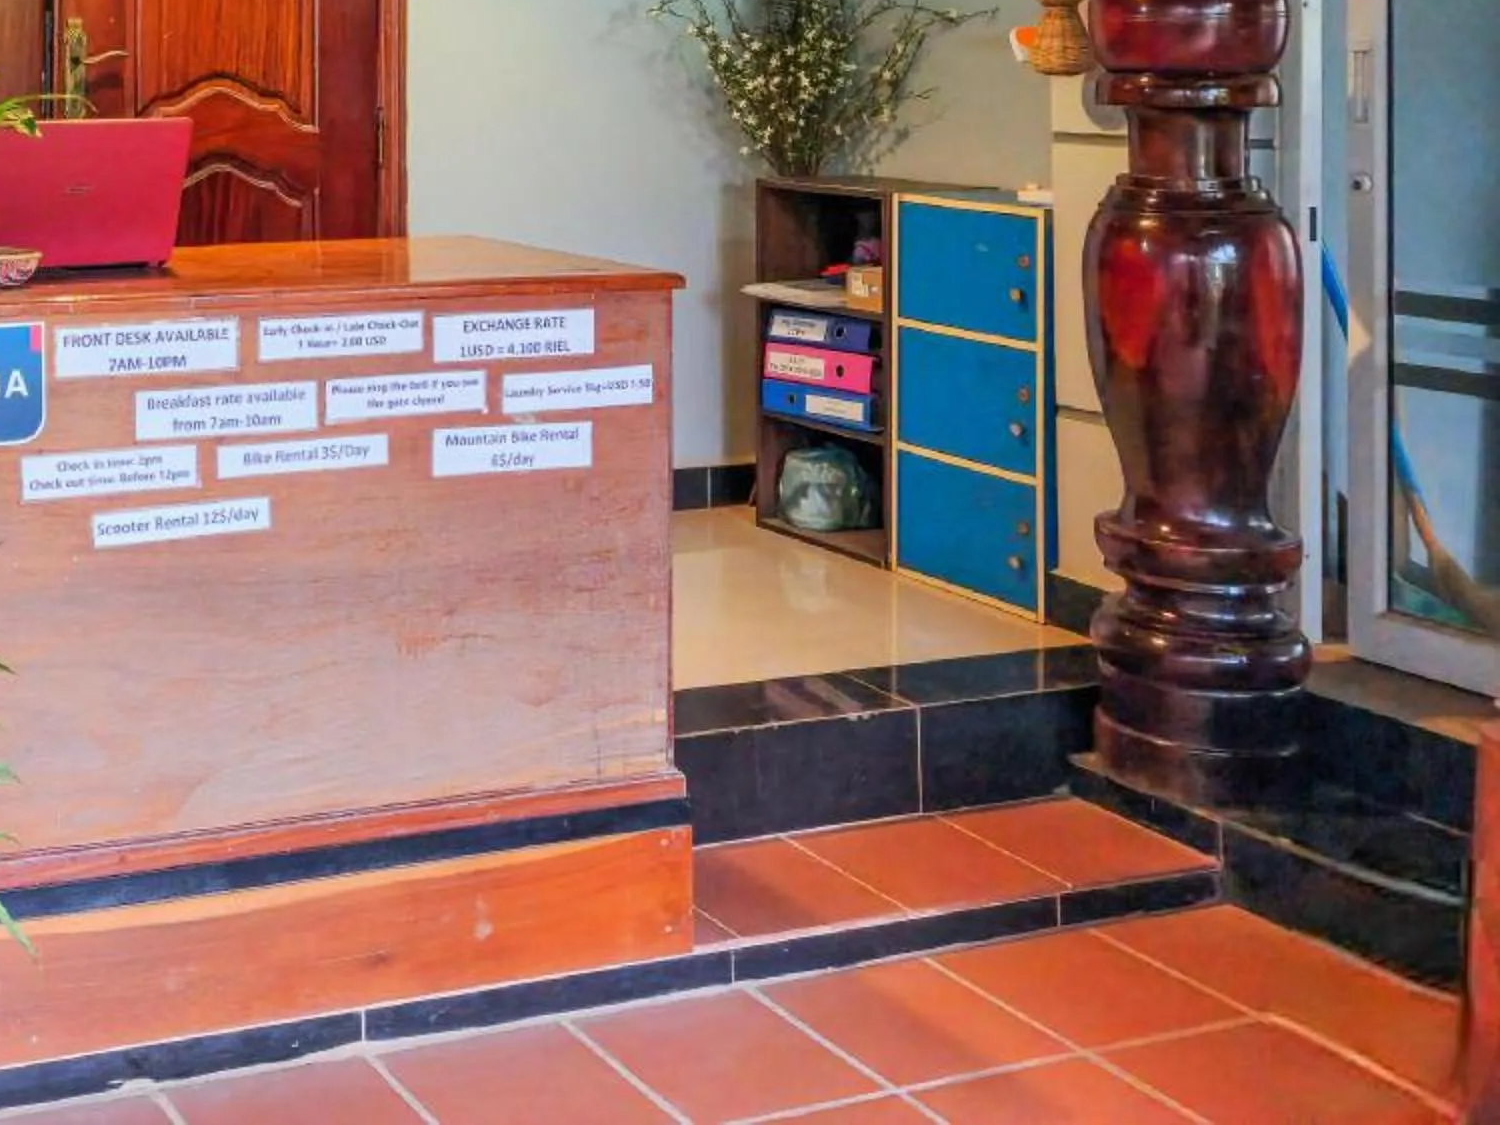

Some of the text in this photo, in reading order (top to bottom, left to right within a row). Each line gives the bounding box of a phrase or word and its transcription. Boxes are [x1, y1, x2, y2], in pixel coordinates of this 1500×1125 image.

[463, 316, 566, 333] EXCHANGE RATE
[63, 328, 230, 348] FRONT DESK AVAILABLE
[544, 340, 571, 353] RIEL
[108, 354, 188, 372] 7AM-10PM
[147, 388, 307, 411] Breakfast rate available
[172, 418, 206, 432] from
[445, 427, 579, 448] Mountain Bike Rental
[275, 446, 318, 463] Rental
[56, 460, 89, 472] Check
[29, 478, 62, 491] Check
[97, 520, 151, 536] Scooter
[155, 513, 199, 531] Rental
